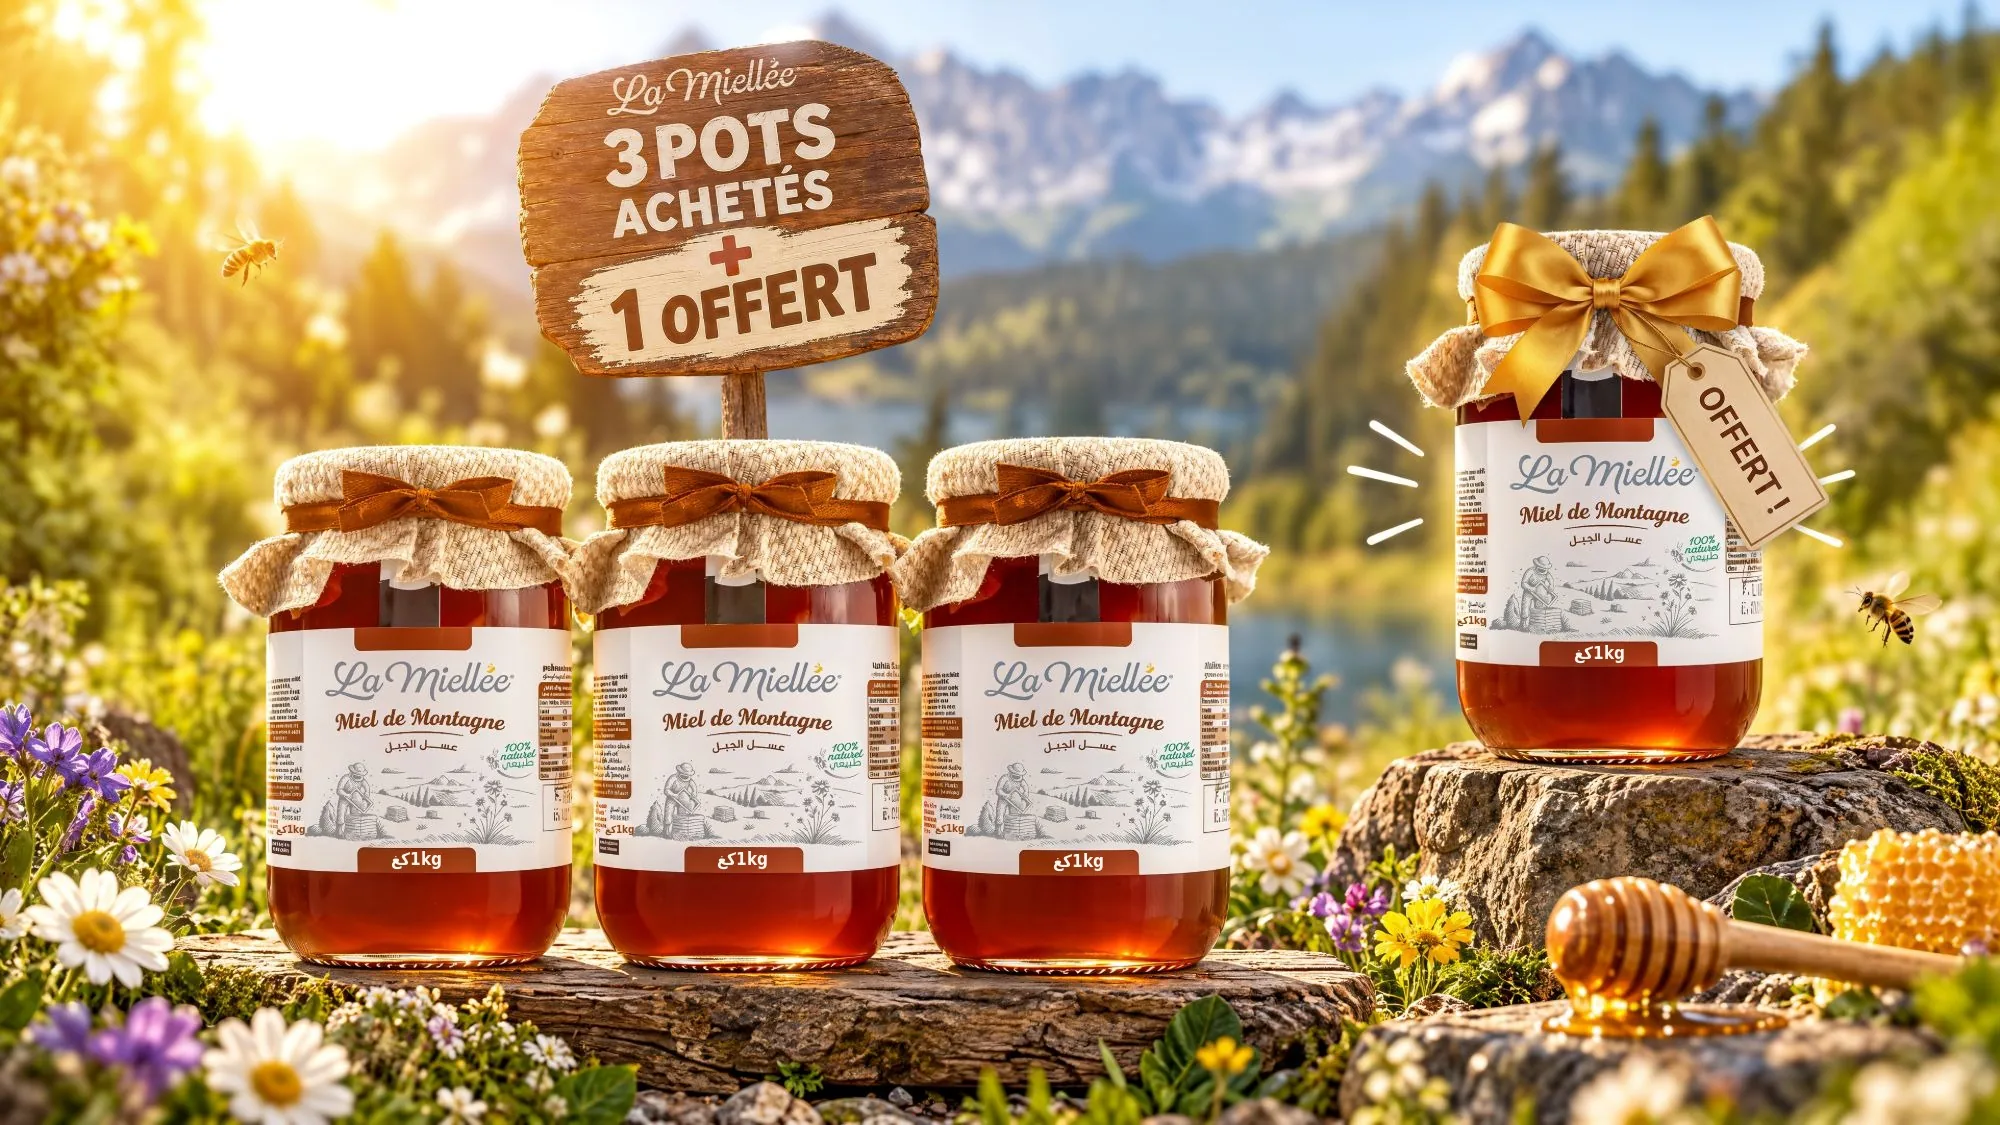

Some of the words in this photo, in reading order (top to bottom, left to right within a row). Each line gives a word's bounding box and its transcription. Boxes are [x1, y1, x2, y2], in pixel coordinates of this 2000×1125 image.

[606, 75, 667, 116] La
[666, 57, 798, 105] Miellée
[604, 128, 648, 188] 3
[655, 103, 836, 180] POTS
[613, 165, 833, 239] ACHETÉS
[610, 287, 645, 352] 1
[661, 252, 877, 345] OFFERT
[1699, 387, 1782, 495] OFFERT
[1510, 454, 1568, 494] La
[1520, 503, 1563, 525] Miel
[1567, 502, 1590, 520] de
[1595, 501, 1690, 528] Montagne
[1685, 543, 1721, 554] naturel
[1689, 534, 1716, 546] 100%
[325, 661, 383, 700] La
[652, 661, 711, 700] La
[984, 661, 1042, 700] La
[335, 710, 378, 731] Miel
[383, 709, 406, 726] de
[411, 708, 505, 734] Montagne
[662, 710, 706, 731] Miel
[710, 709, 733, 726] de
[738, 708, 832, 734] Montagne
[994, 710, 1037, 731] Miel
[1042, 709, 1065, 726] de
[1070, 708, 1164, 734] Montagne
[500, 749, 537, 760] naturel
[505, 741, 531, 752] 100%
[827, 749, 864, 760] naturel
[832, 741, 859, 752] 100%
[1159, 749, 1196, 760] naturel
[1163, 741, 1190, 752] 100%
